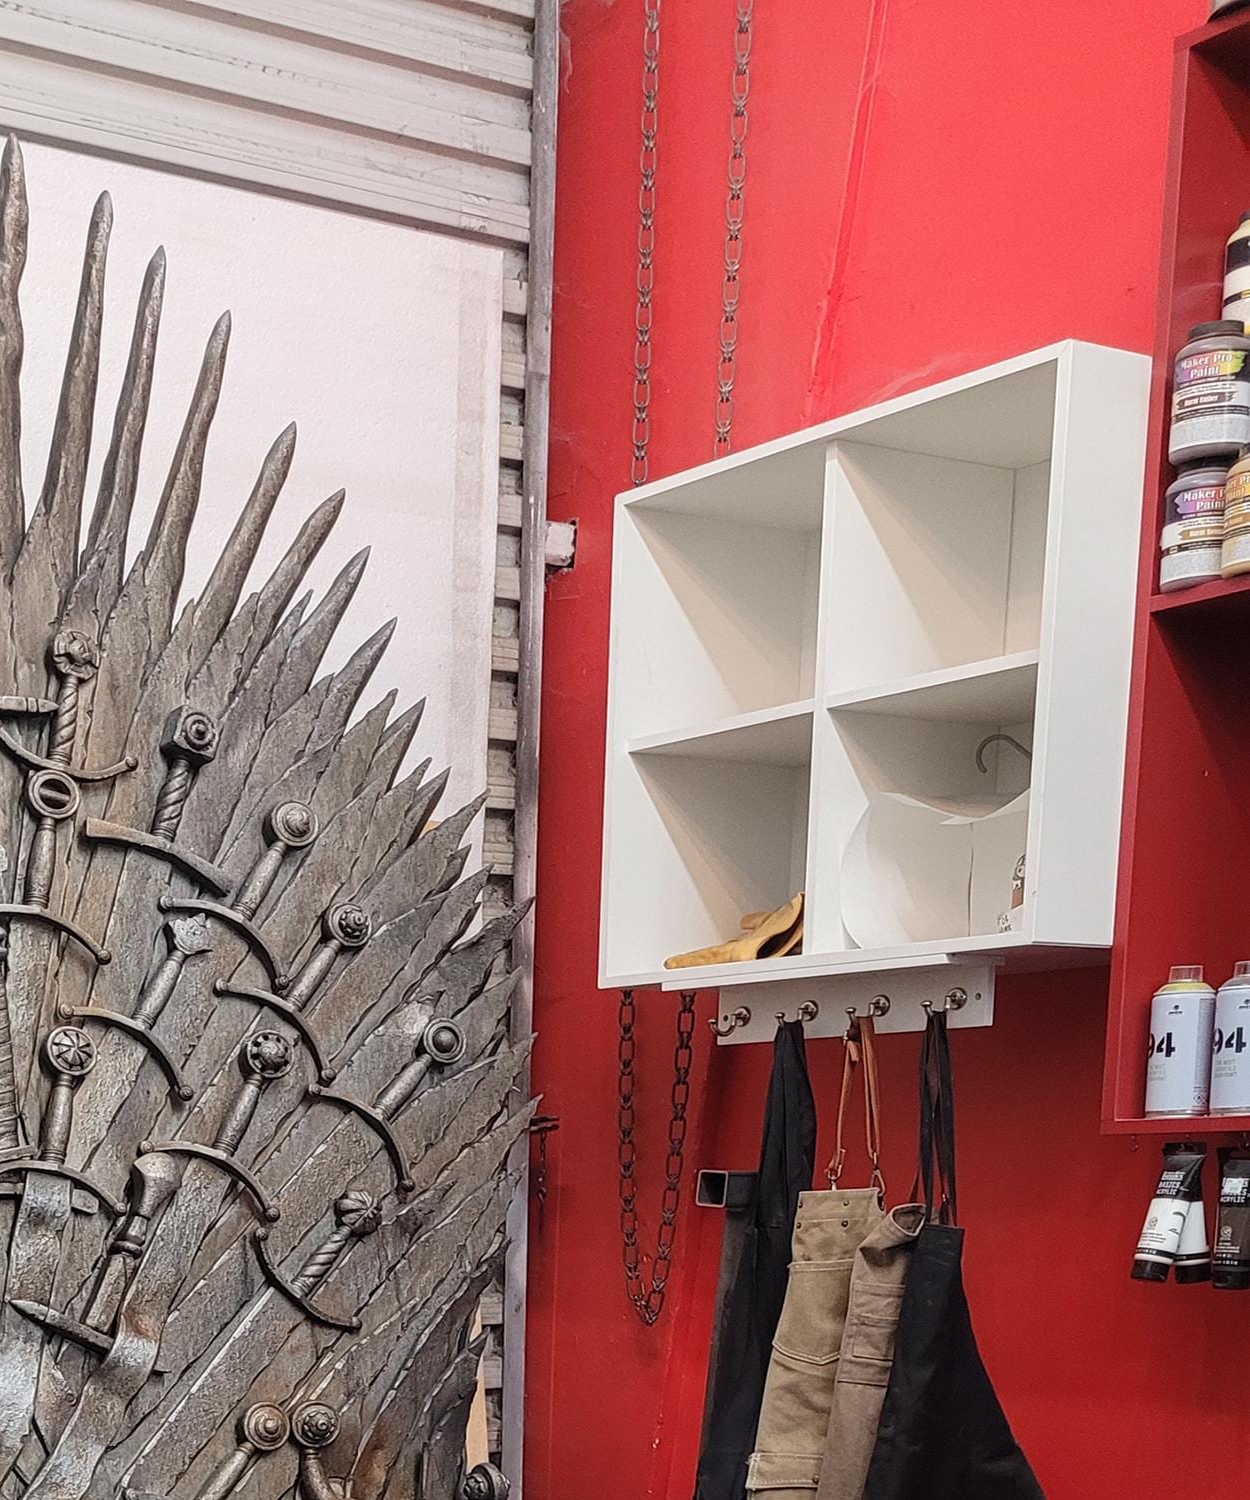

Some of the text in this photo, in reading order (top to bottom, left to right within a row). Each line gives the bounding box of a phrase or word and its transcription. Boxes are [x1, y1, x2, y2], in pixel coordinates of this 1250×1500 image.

[1180, 353, 1232, 370] Maker Pro
[1190, 366, 1219, 379] Paint
[1183, 489, 1215, 502] Maker
[1213, 1026, 1247, 1055] 94
